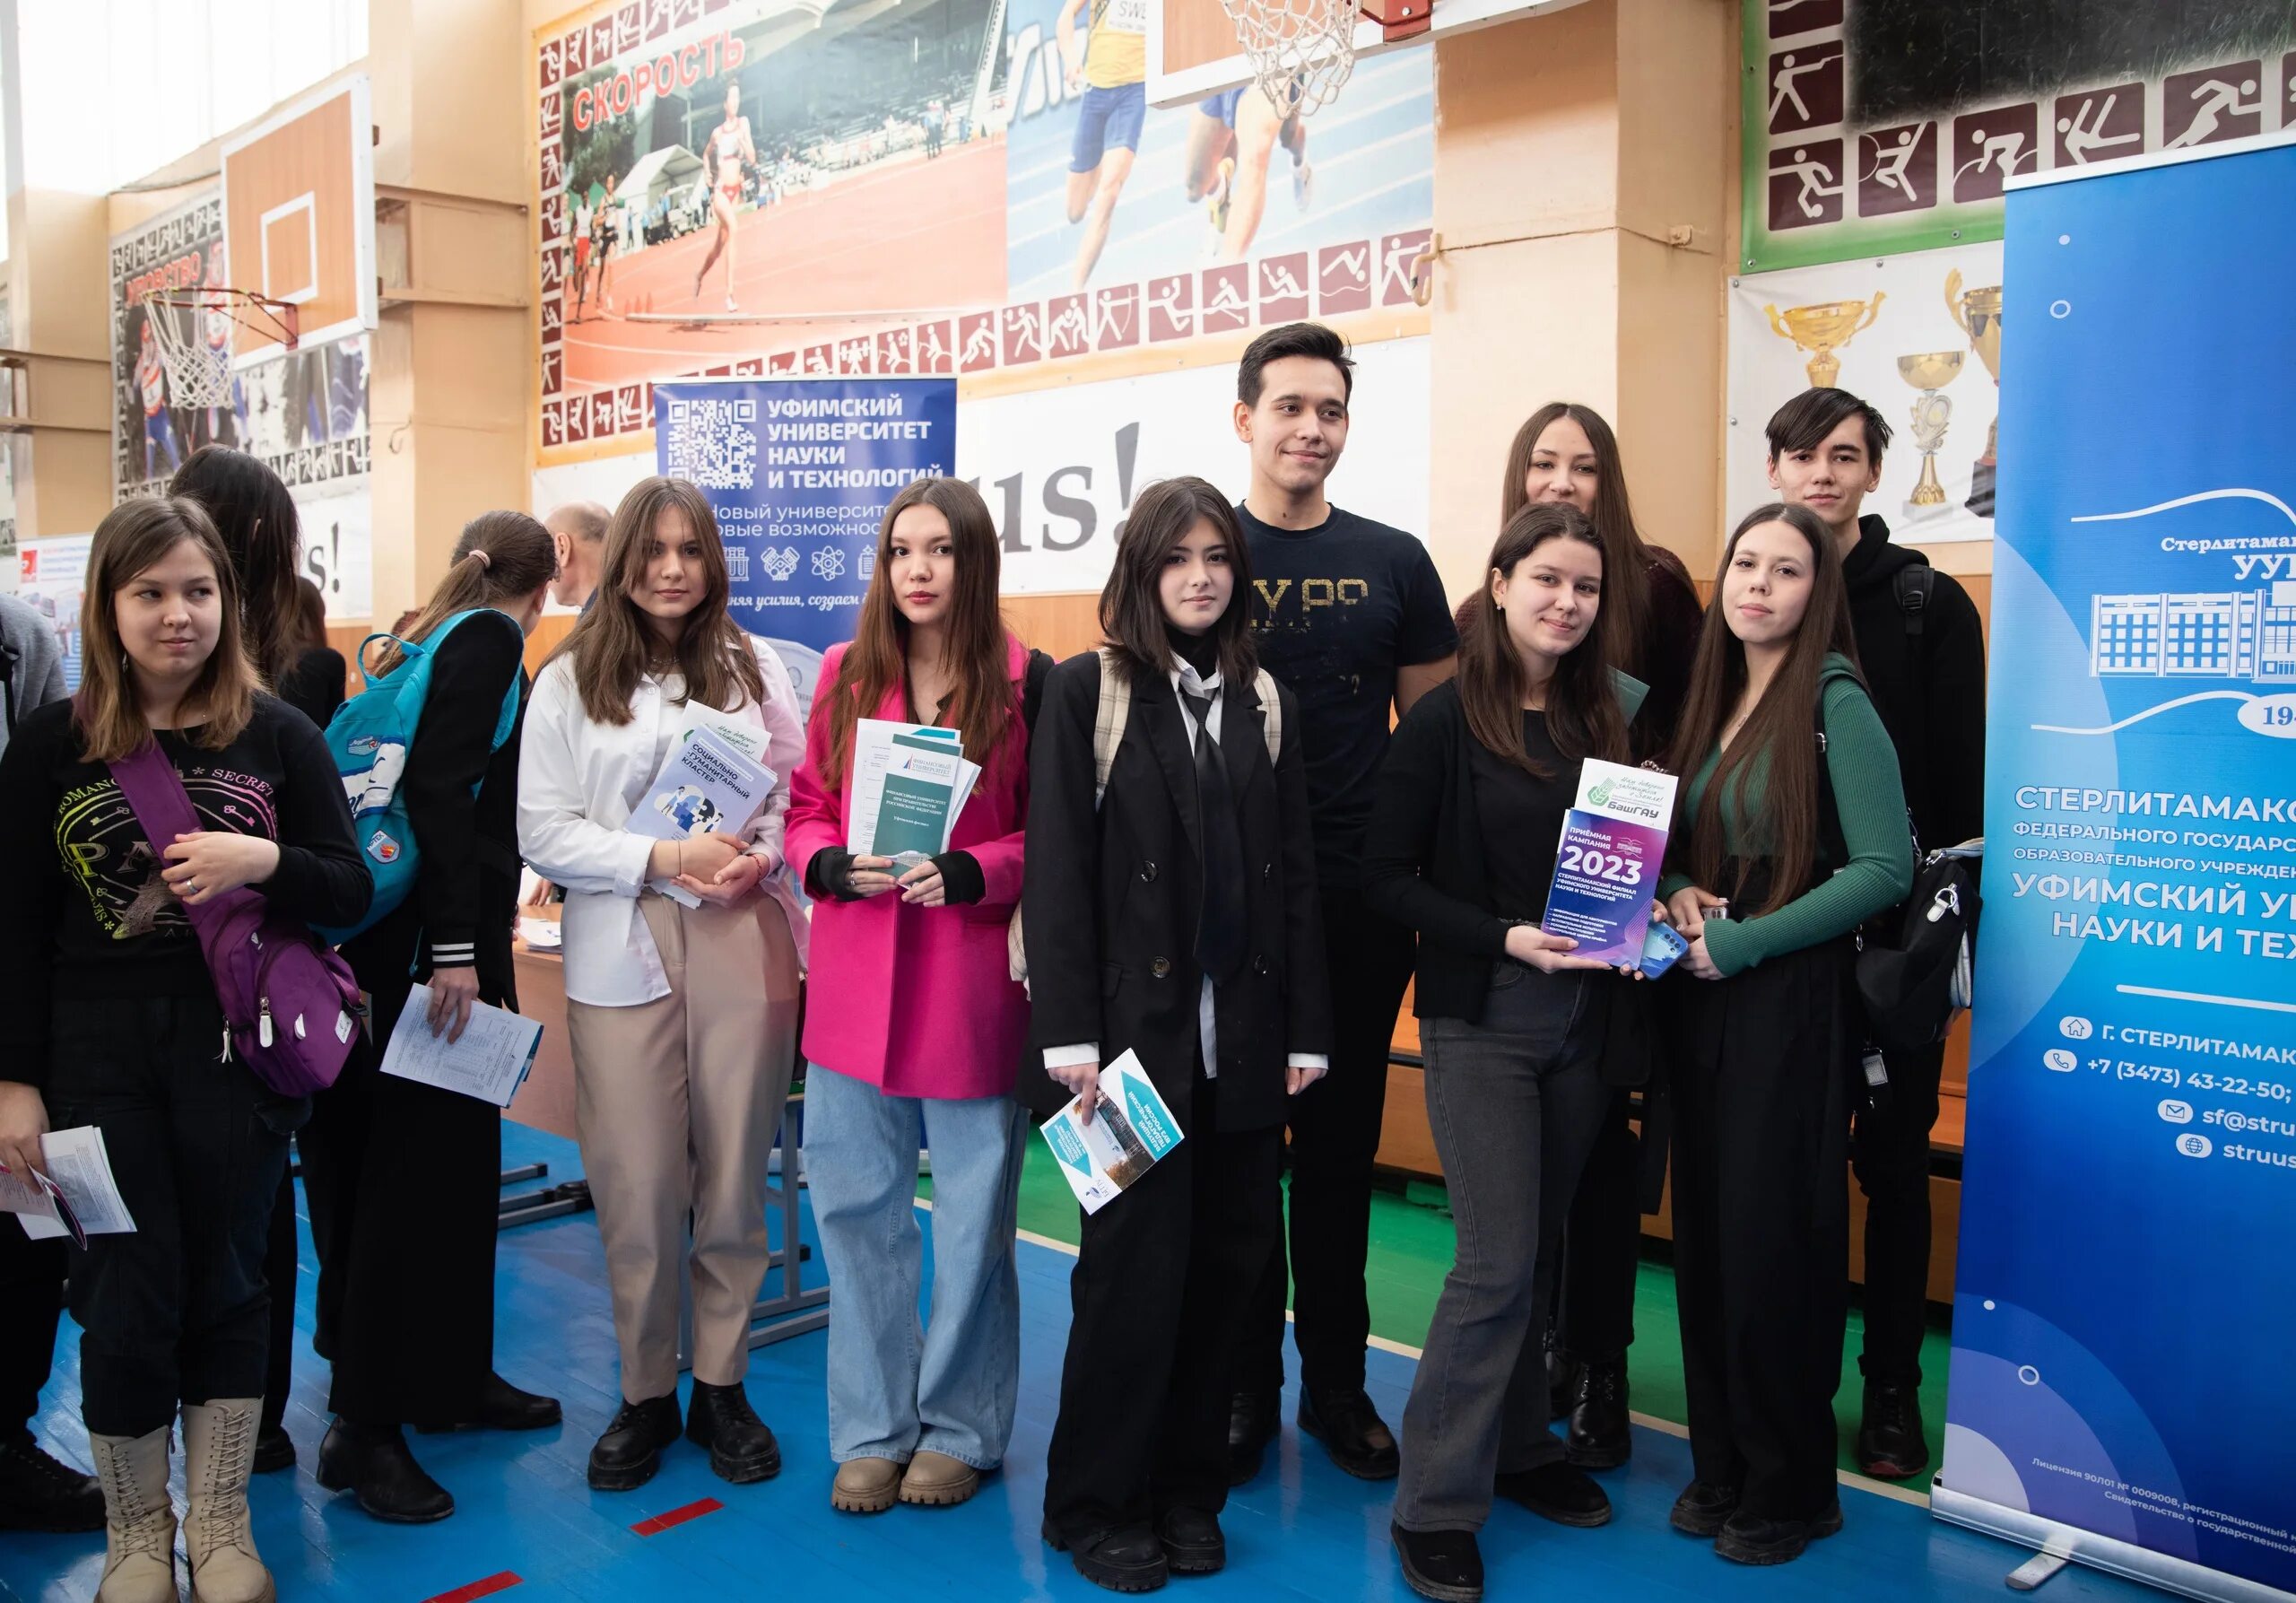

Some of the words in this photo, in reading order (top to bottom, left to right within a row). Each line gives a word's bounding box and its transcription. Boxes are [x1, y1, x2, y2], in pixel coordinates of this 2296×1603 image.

[572, 29, 744, 132] СКОРОСТЬ
[768, 394, 903, 418] УФИМСКИЙ
[768, 422, 933, 442] УНИВЕРСИТЕТ
[768, 447, 846, 466] НАУКИ
[768, 471, 785, 489] И
[2161, 536, 2296, 554] Стерлитама
[755, 595, 804, 612] усилия,
[808, 595, 859, 612] создаем
[2262, 705, 2296, 727] 19
[682, 756, 716, 784] КЛАСТЕР
[692, 744, 738, 780] СОЦИАЛЬНО
[687, 751, 751, 799] -ГУМАНИТАРНЫЙ
[1607, 801, 1659, 819] БашГАУ
[1568, 834, 1611, 849] КАМПАНИЯ
[1570, 827, 1612, 842] ПРИЁМНАЯ
[2013, 821, 2178, 845] ФЕДЕРАЛЬНОГО
[1561, 845, 1643, 885] 2023
[2013, 848, 2196, 871] ОБРАЗОВАТЕЛЬНОГО
[1555, 884, 1574, 893] НАУКИ
[1579, 888, 1615, 902] ТЕХНОЛОГИЙ
[1556, 878, 1590, 890] УФИМСКОГО
[1590, 885, 1633, 900] УНИВЕРСИТЕТА
[1558, 872, 1611, 889] СТЕРЛИТАМАКСКИЙ
[1612, 884, 1637, 895] ФИЛИАЛ
[2012, 872, 2247, 917] УФИМСКИЙ
[2052, 911, 2183, 948] НАУКИ
[2196, 925, 2223, 953] И
[2102, 1024, 2115, 1041] Г.
[2120, 1027, 2296, 1066] СТЕРЛИТАМАК
[2087, 1059, 2111, 1075] +7
[2117, 1060, 2181, 1088] (3473)
[2187, 1073, 2292, 1104] 43-22-50;
[1128, 1091, 1166, 1148] ПЕДАГОГИЧЕСКИЙ
[1144, 1103, 1162, 1130] РОССИИ
[2202, 1109, 2296, 1137] sf@stru
[1138, 1120, 1161, 1152] ВЕДУЩИЙ
[1161, 1130, 1171, 1144] ВУЗ
[2031, 1457, 2083, 1479] Лицензия
[2083, 1472, 2115, 1489] 90Л01
[2117, 1481, 2130, 1492] №
[2131, 1485, 2181, 1508] 0009008,
[2182, 1502, 2288, 1539] регистрационный
[2104, 1490, 2185, 1520] Свидетельство
[2187, 1515, 2195, 1524] о
[2196, 1519, 2296, 1555] государственной
